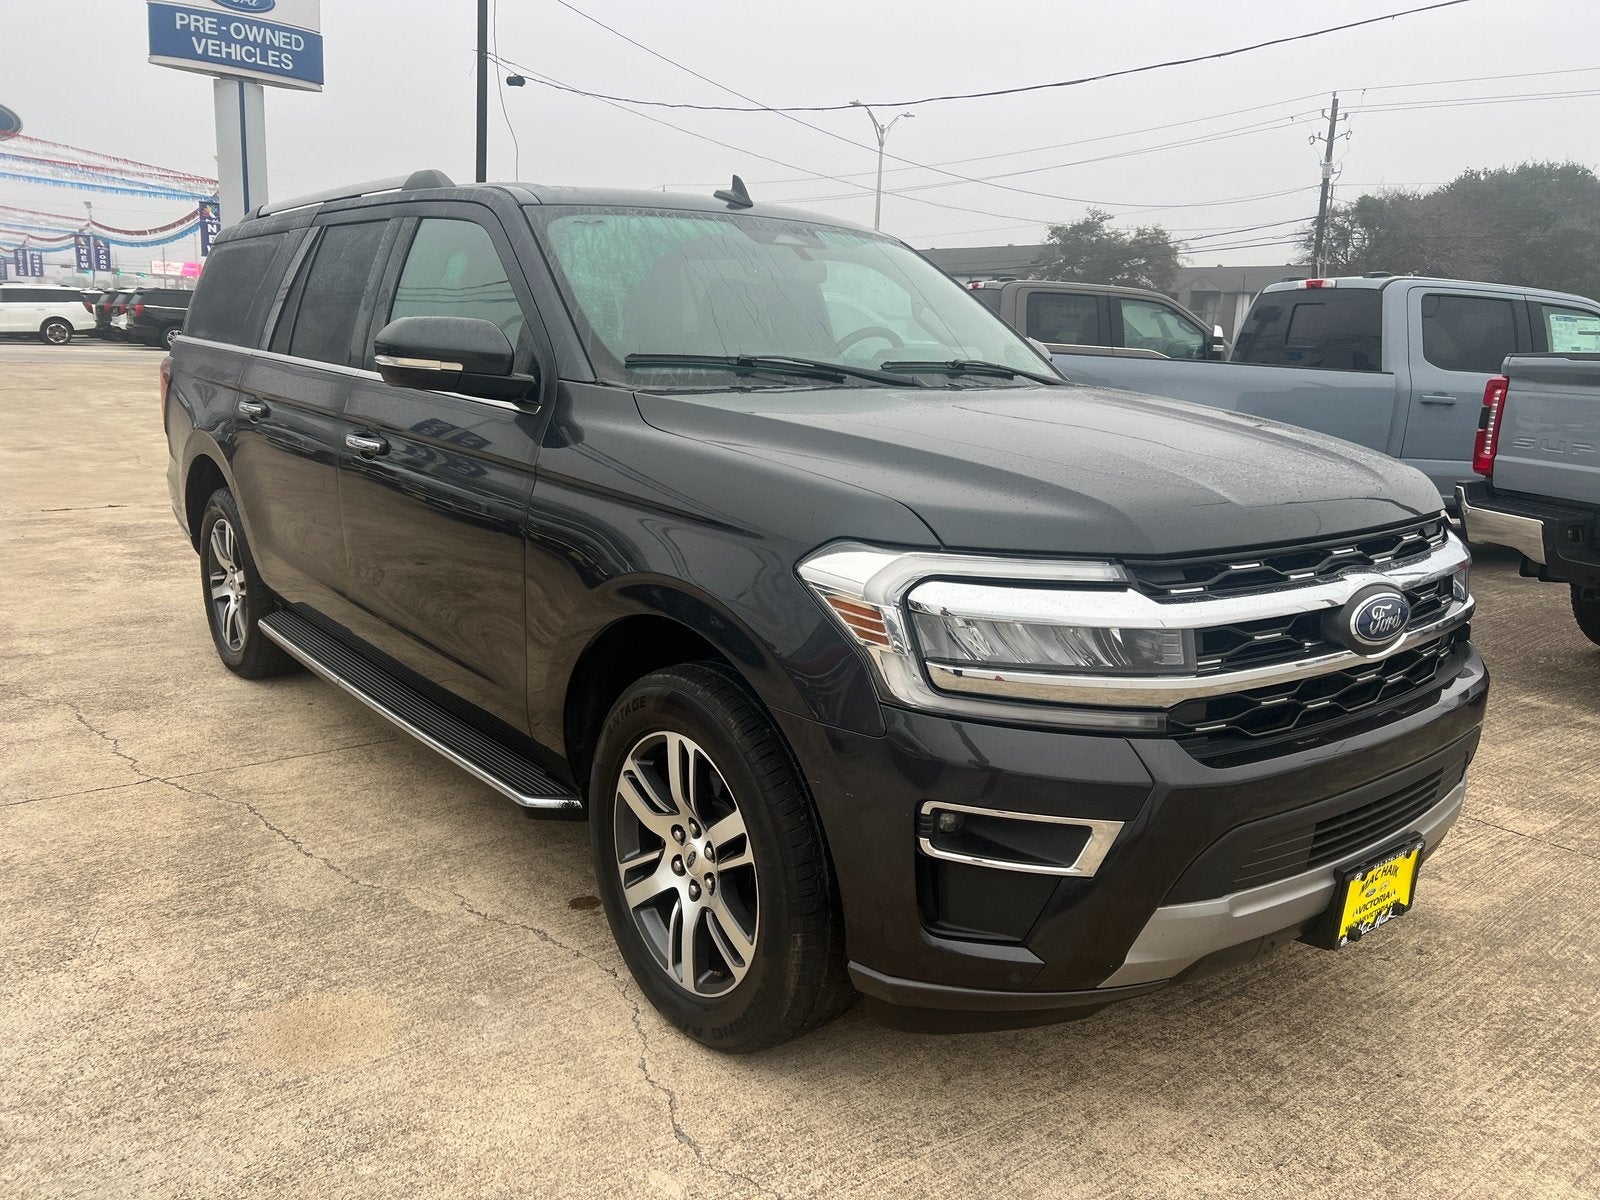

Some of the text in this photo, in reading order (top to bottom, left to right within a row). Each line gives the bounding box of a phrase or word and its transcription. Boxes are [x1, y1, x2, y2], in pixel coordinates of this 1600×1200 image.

[191, 36, 293, 71] VEHICLES
[79, 248, 89, 269] NEW
[98, 248, 108, 270] FORD
[1369, 603, 1402, 635] Ford
